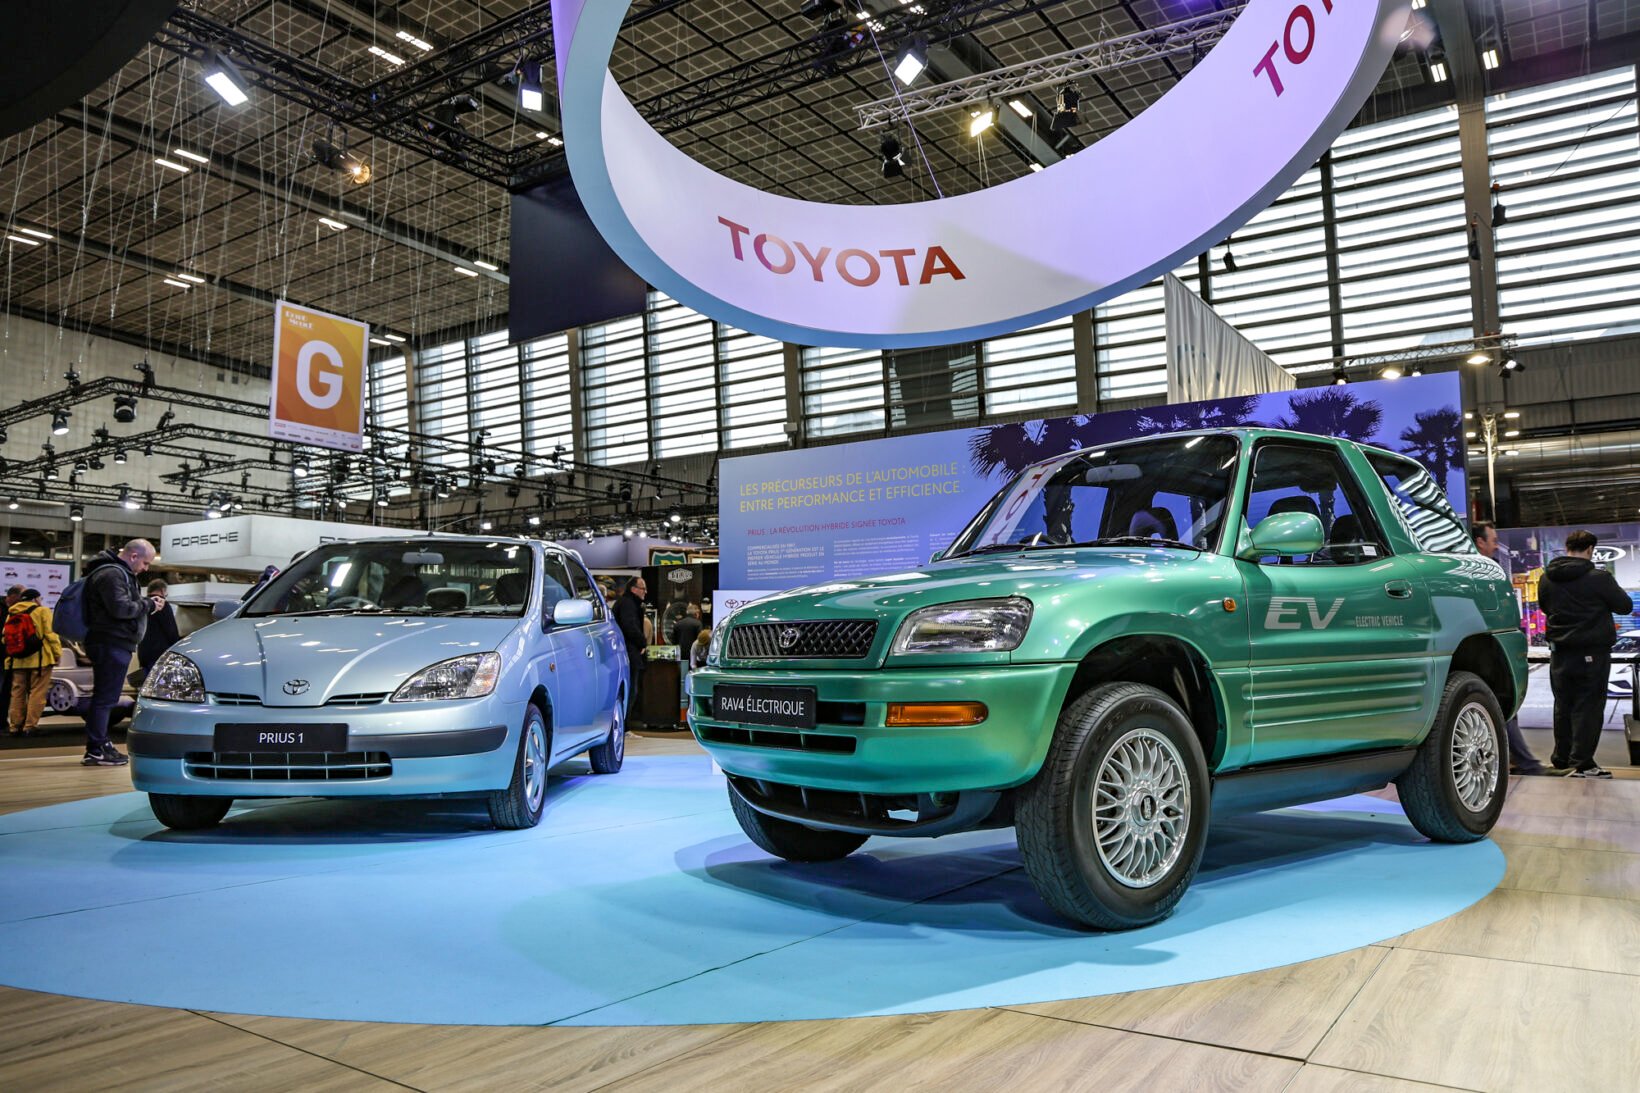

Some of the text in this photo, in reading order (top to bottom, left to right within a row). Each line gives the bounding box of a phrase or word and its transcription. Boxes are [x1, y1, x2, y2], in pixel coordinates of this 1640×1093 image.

[1253, 0, 1333, 97] TO
[717, 215, 966, 287] TOYOTA
[296, 340, 343, 409] G
[740, 482, 759, 496] LES
[846, 472, 862, 486] DE
[866, 461, 958, 483] L'AUTOMOBILE
[740, 498, 774, 512] ENTRE
[777, 489, 865, 509] PERFORMANCE
[869, 488, 882, 501] ET
[821, 521, 850, 531] HYBRIDE
[878, 517, 906, 527] TOYOTA
[171, 531, 239, 548] PORSCHE
[1263, 596, 1345, 630] EV
[1355, 615, 1404, 628] ELECTRIC VEHICLE
[721, 694, 805, 716] RAV4 ÉLECTRIQUE
[259, 732, 304, 744] PRIUS 1
